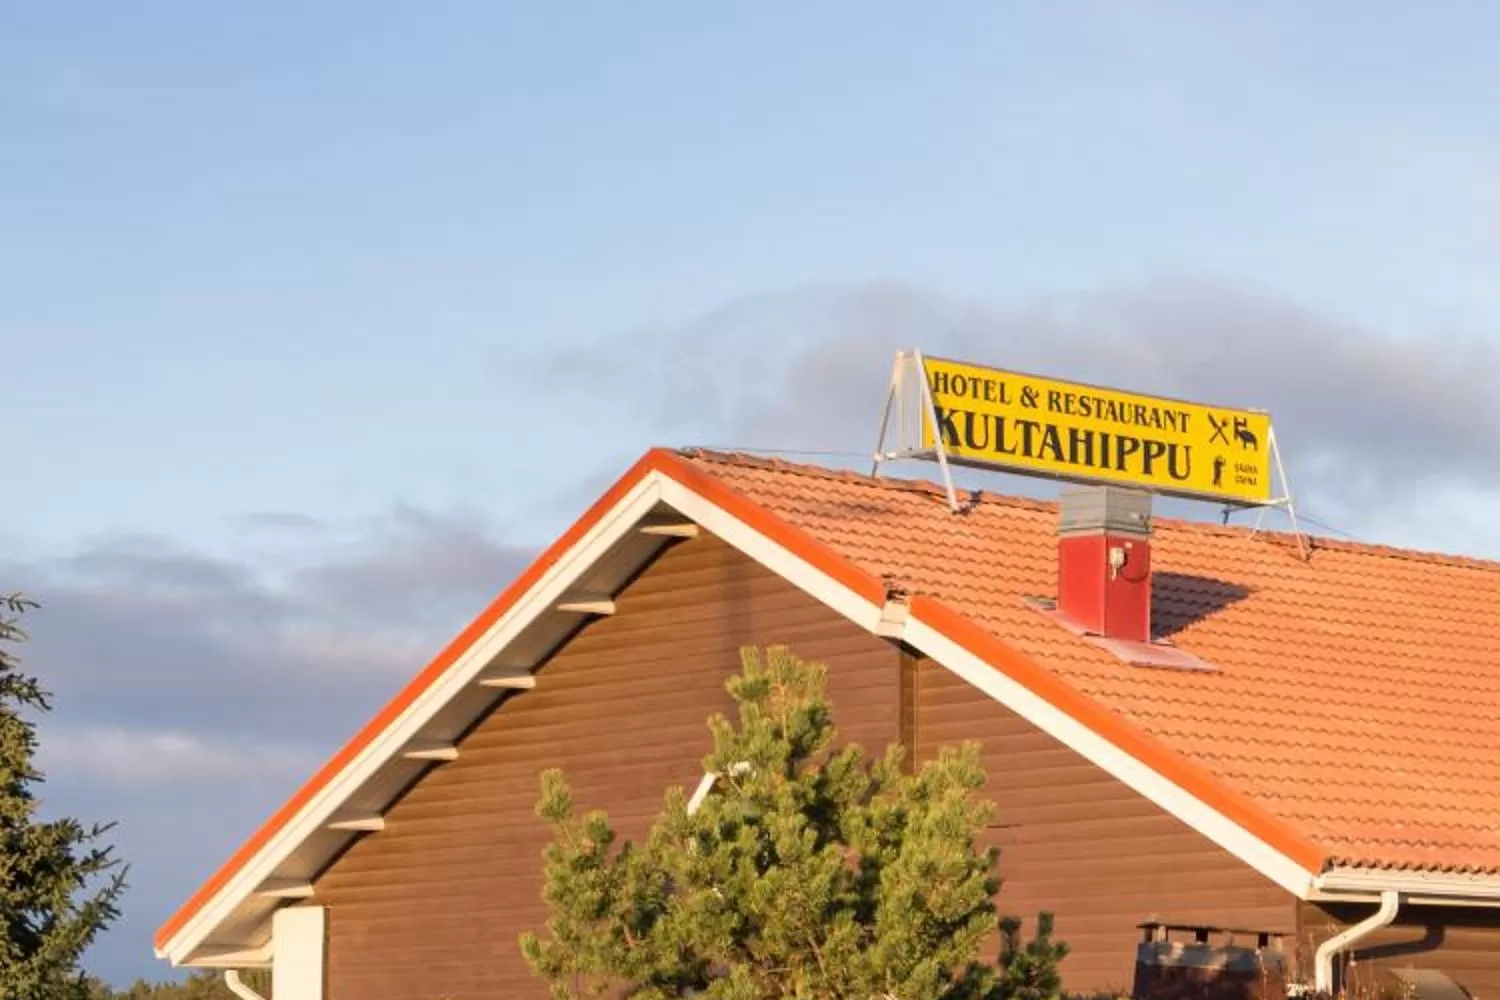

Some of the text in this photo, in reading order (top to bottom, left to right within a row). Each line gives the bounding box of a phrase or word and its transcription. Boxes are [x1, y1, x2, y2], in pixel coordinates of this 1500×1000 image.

[933, 371, 1191, 433] HOTEL & RESTAURANT
[932, 406, 1193, 481] KULTAHIPPU
